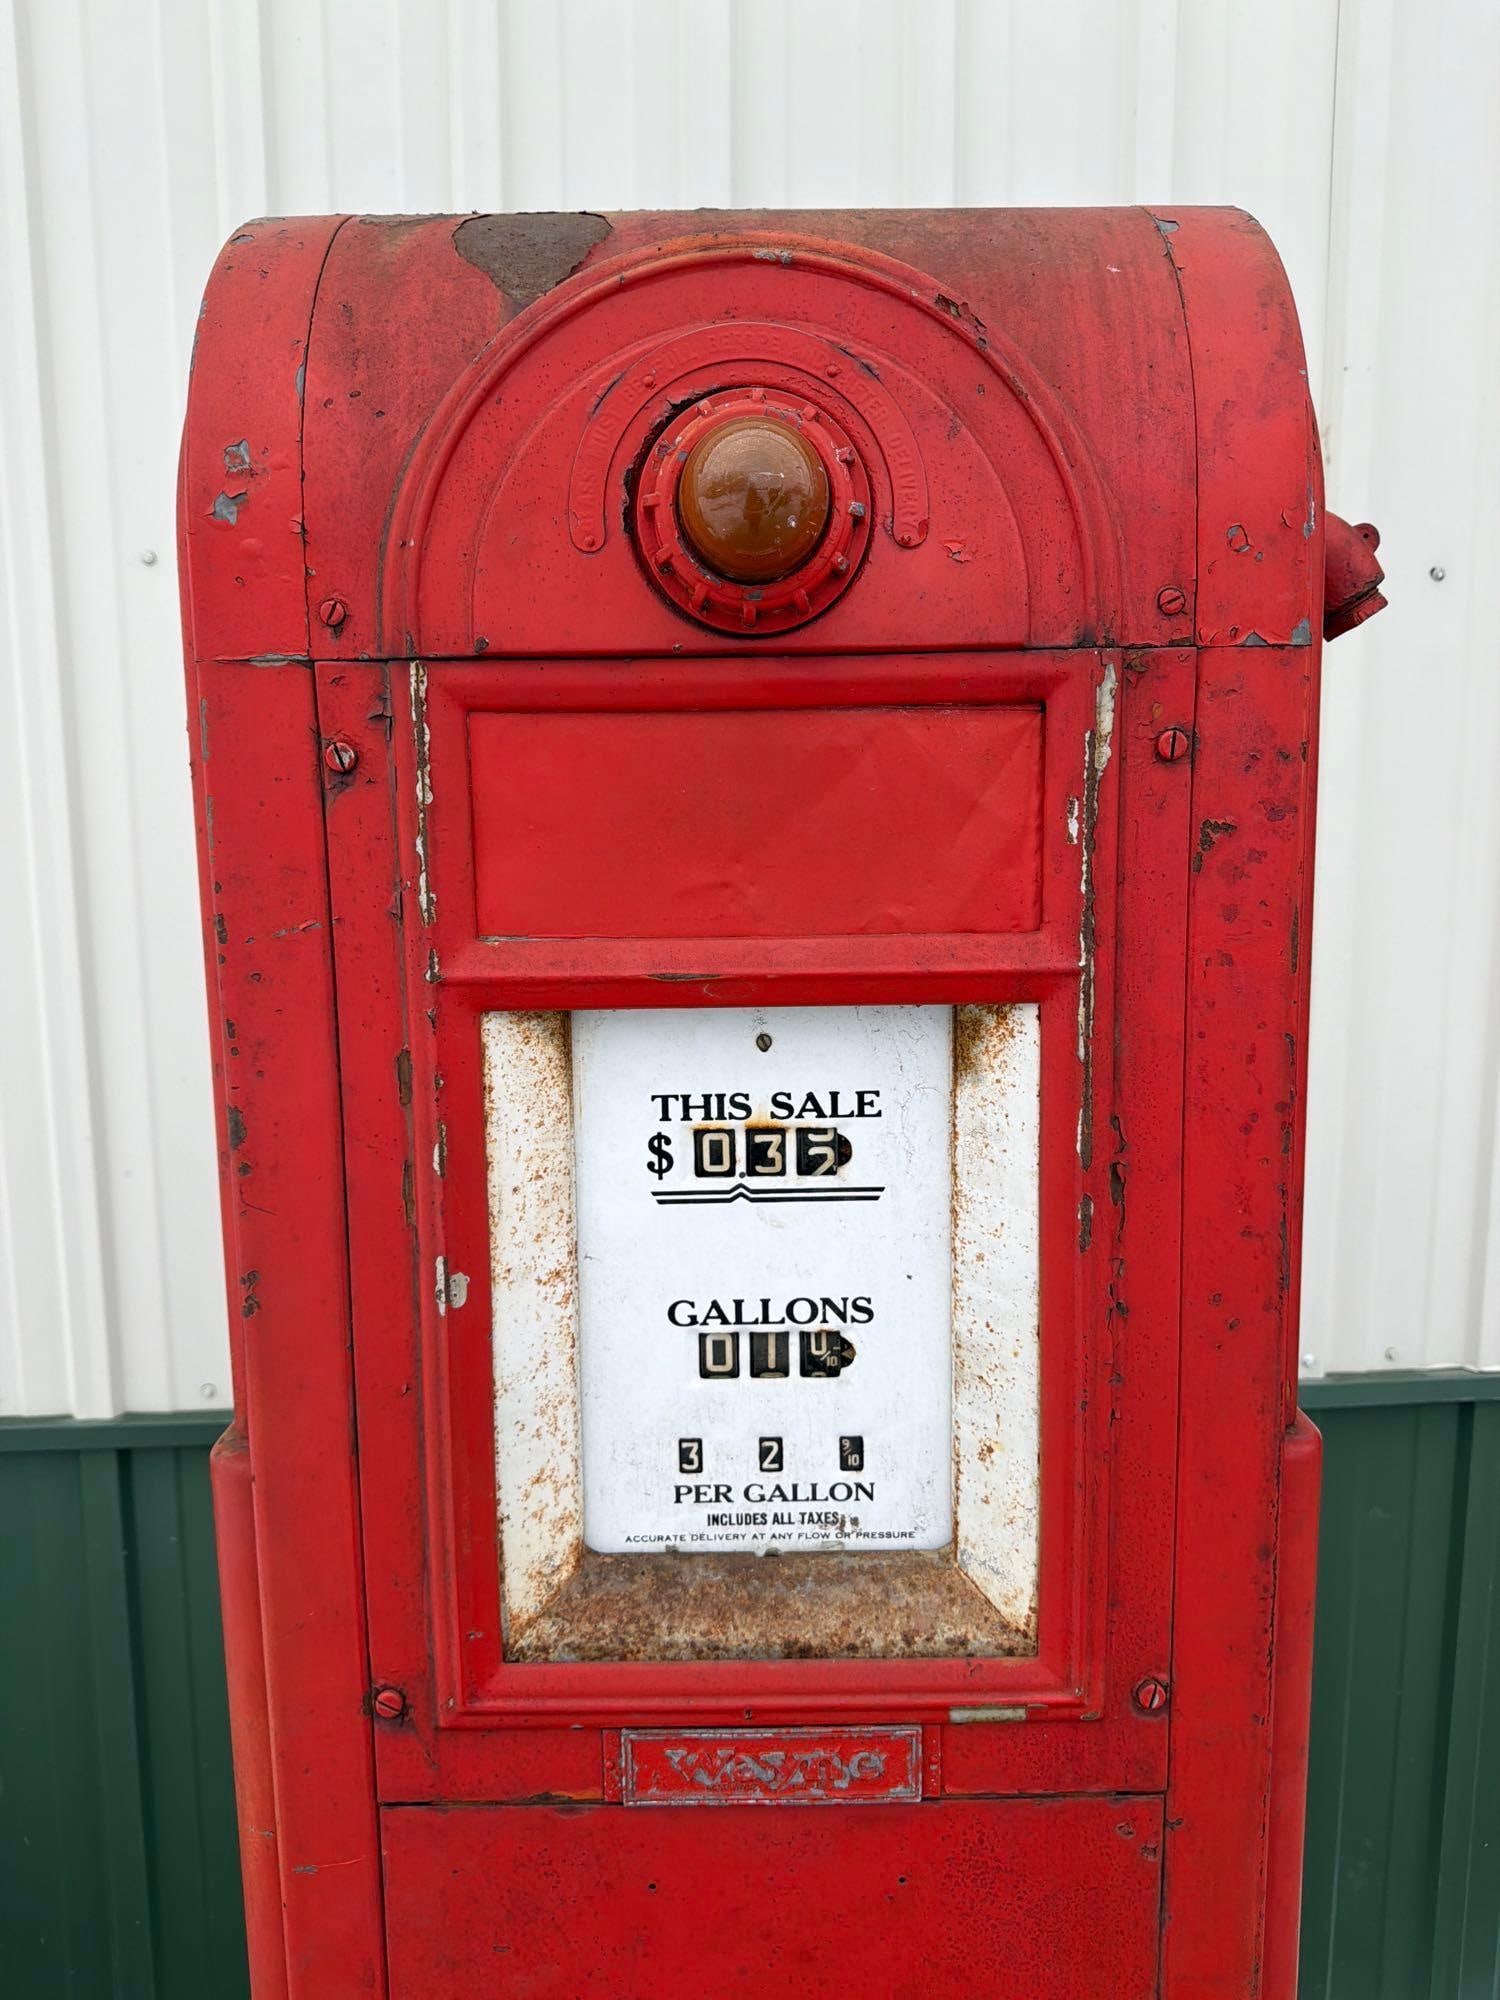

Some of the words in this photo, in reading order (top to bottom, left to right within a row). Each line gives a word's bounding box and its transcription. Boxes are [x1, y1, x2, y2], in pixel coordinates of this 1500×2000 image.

[650, 1093, 752, 1122] THIS
[770, 1090, 882, 1120] SALE
[647, 1132, 674, 1180] $
[667, 1297, 874, 1326] GALLONS
[681, 1442, 699, 1470] 3
[761, 1441, 780, 1469] 2
[674, 1485, 733, 1504] PER
[743, 1482, 875, 1503] GALLON
[707, 1513, 768, 1526] INCLUDES
[772, 1512, 795, 1525] ALL
[799, 1511, 839, 1525] TAXES
[625, 1535, 687, 1543] ACCURATE
[691, 1533, 747, 1542] DELIVERY
[751, 1533, 766, 1541] AT
[770, 1532, 793, 1540] ANY
[798, 1532, 831, 1540] FLOW
[856, 1531, 916, 1539] PRESSURE
